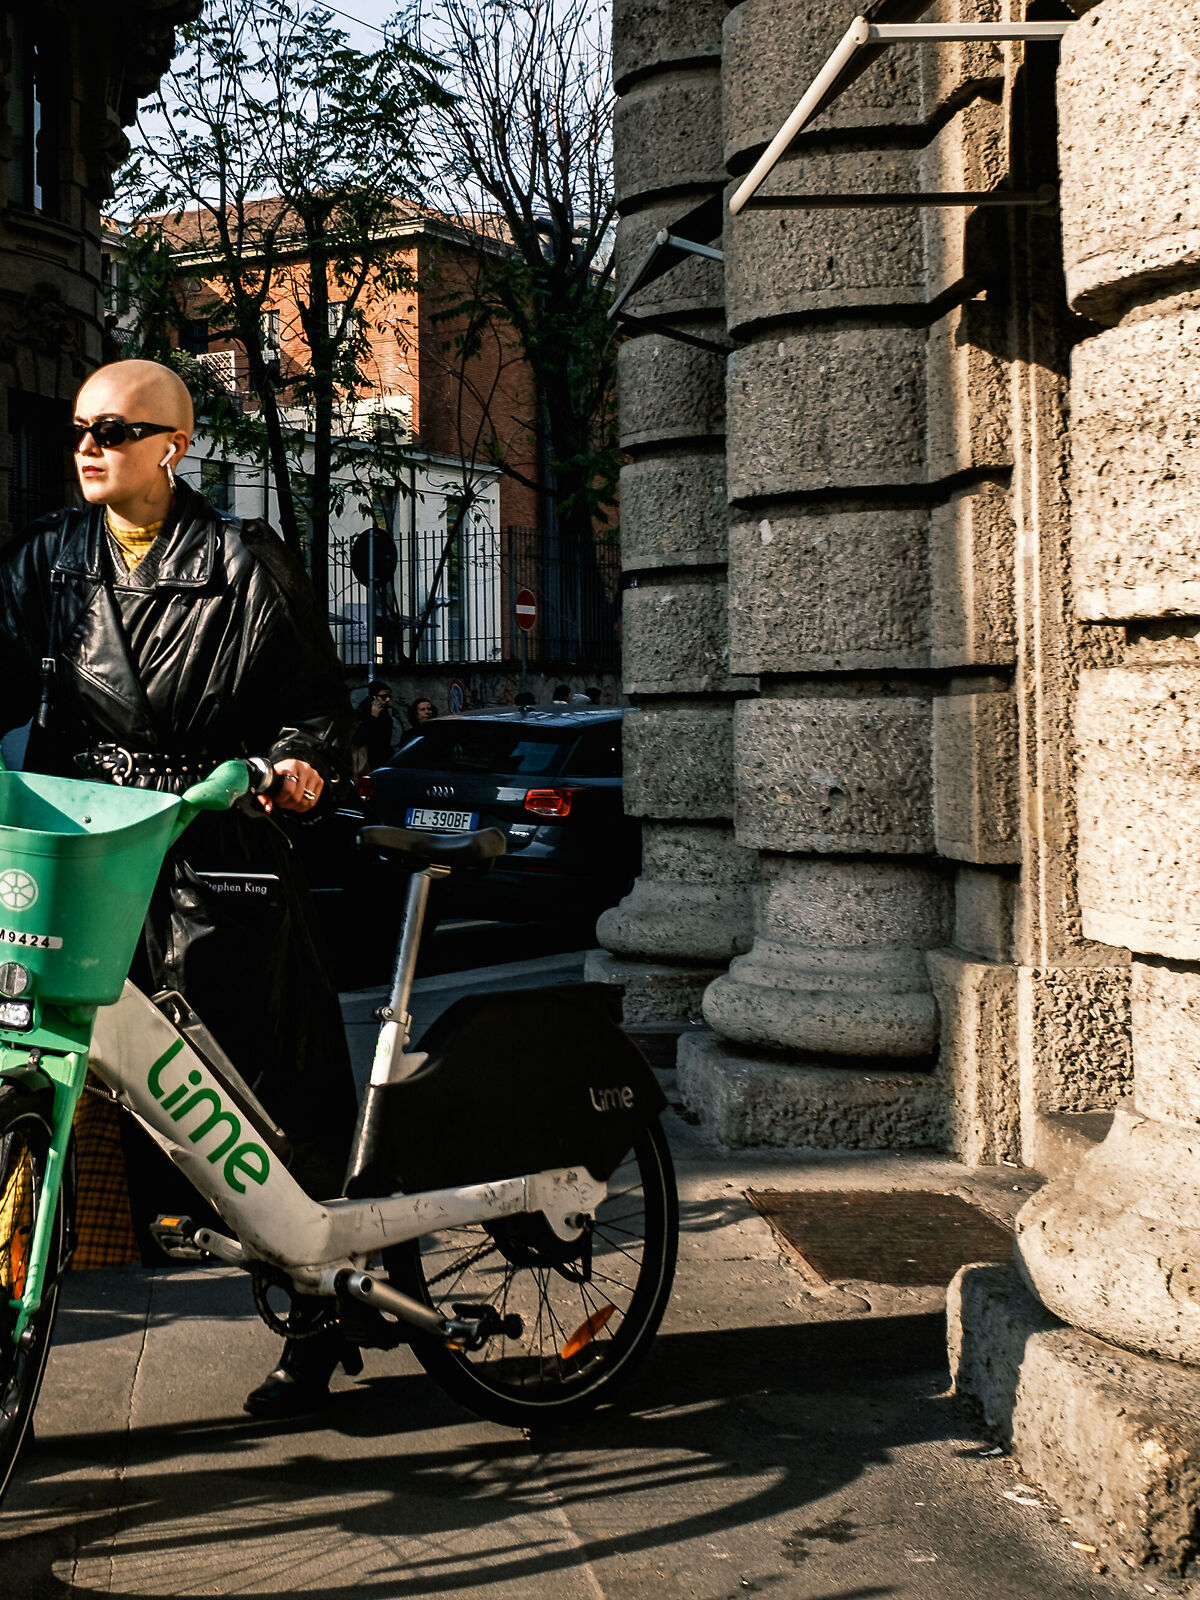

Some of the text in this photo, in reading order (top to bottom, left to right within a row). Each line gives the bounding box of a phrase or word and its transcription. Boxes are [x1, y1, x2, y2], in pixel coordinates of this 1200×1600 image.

[412, 809, 471, 829] FL 390BF
[205, 881, 268, 895] ephen King
[147, 1036, 271, 1194] Lime
